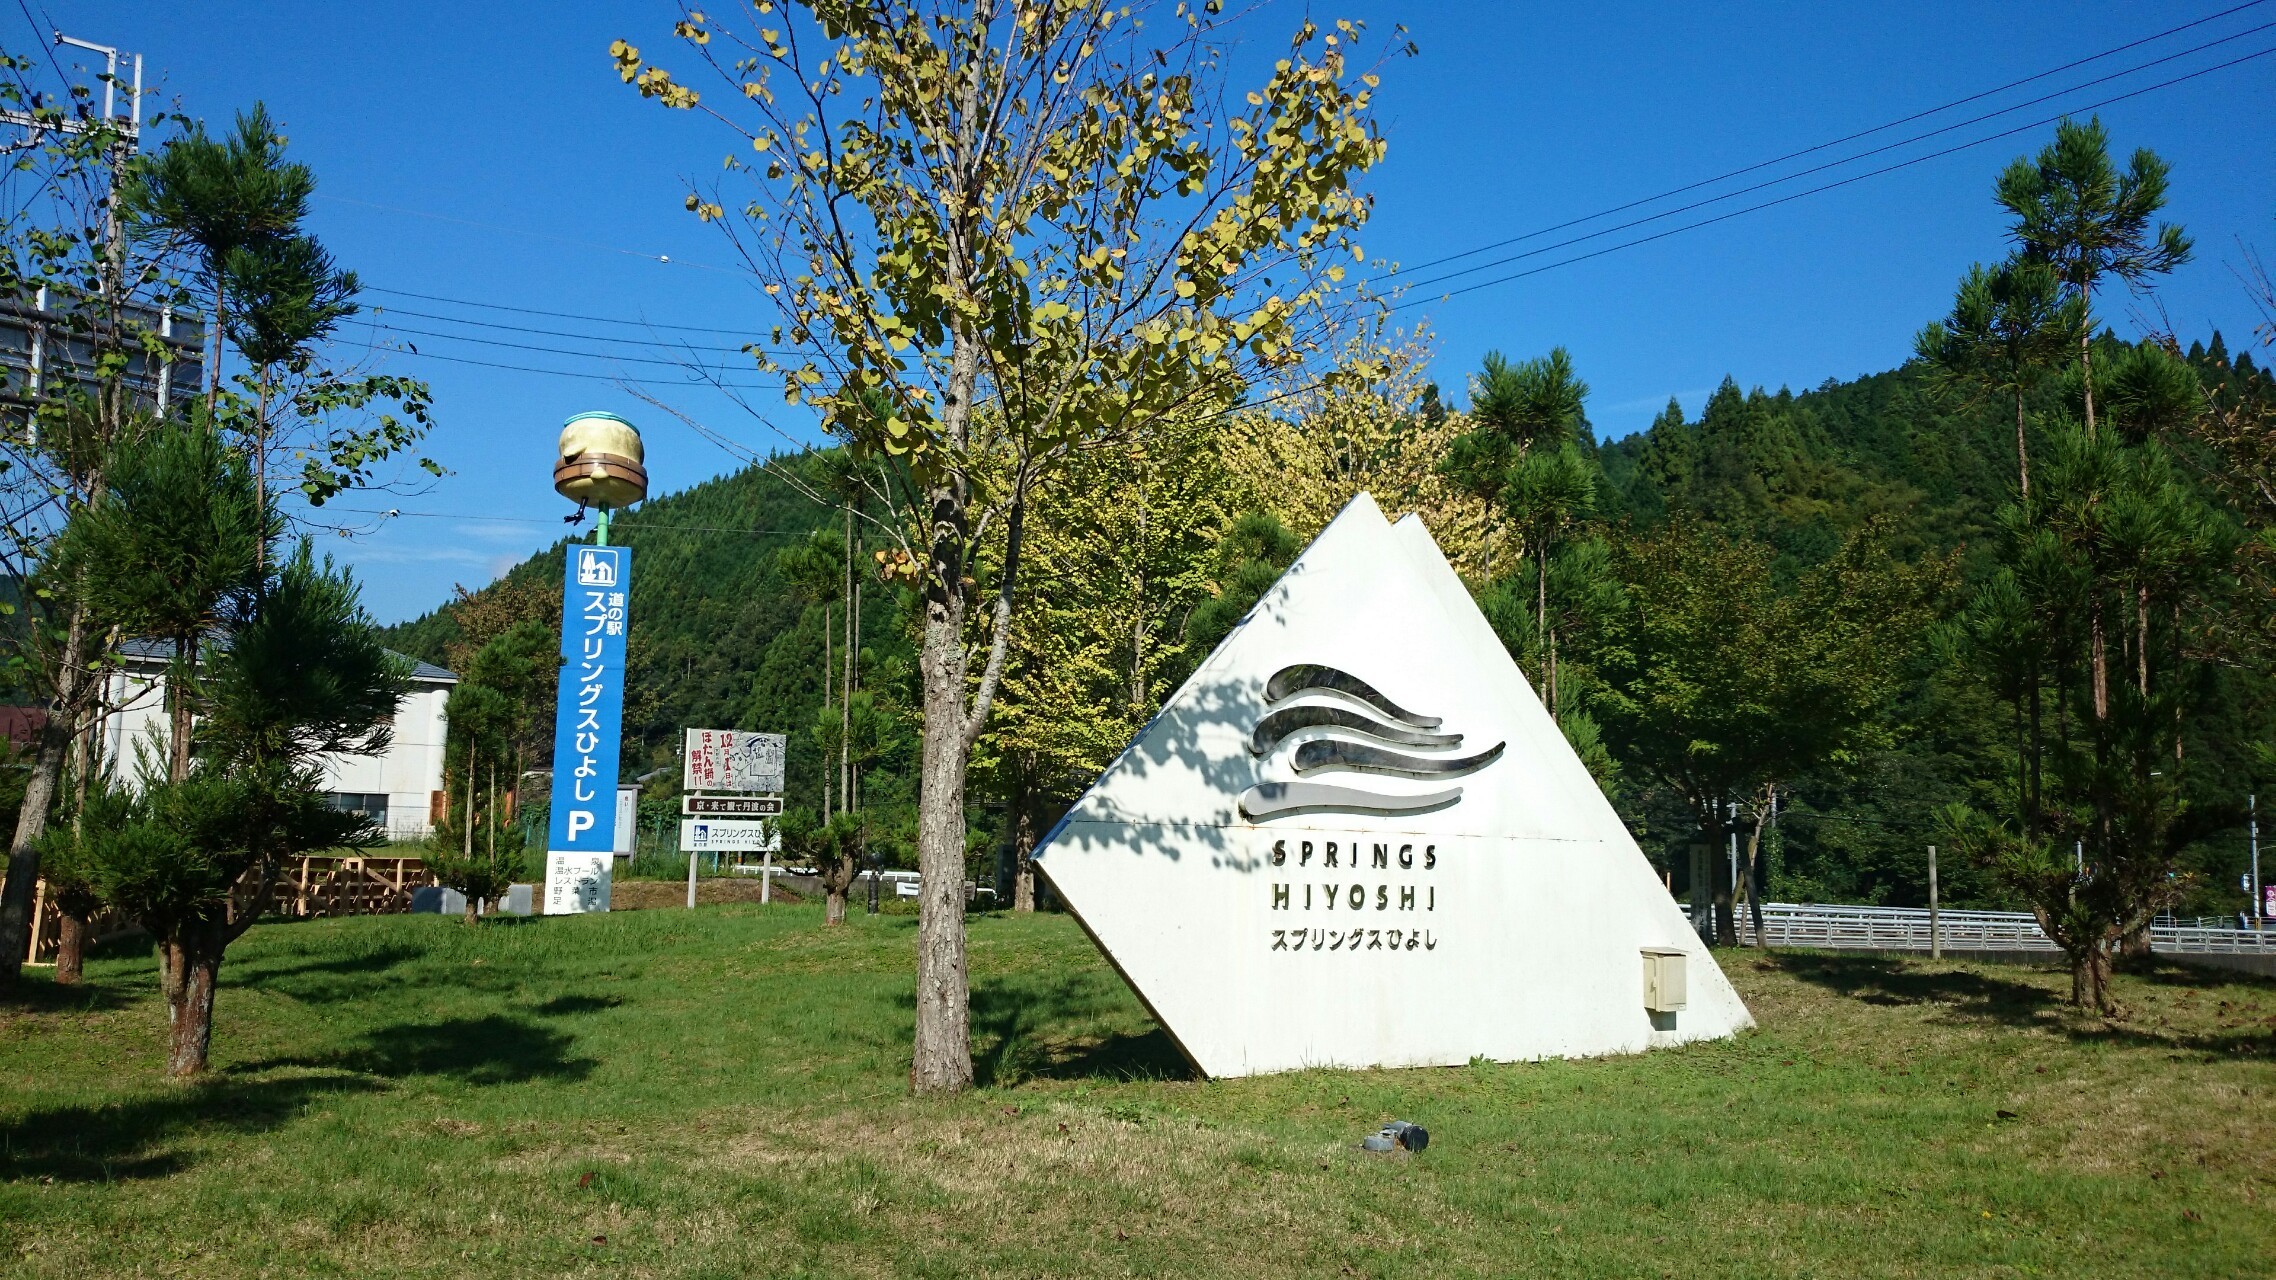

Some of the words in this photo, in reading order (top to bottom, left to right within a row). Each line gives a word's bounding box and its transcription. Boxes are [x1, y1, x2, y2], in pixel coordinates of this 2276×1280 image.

[606, 592, 625, 636] 道の駅
[574, 591, 608, 802] スプリングスひよし
[568, 810, 595, 842] P
[711, 828, 764, 838] スプリングスひ
[1272, 839, 1437, 870] SPRINGS
[555, 876, 599, 885] レストラン
[1271, 883, 1435, 912] HIYOSHI
[1271, 927, 1438, 951] スプリングスひよし
